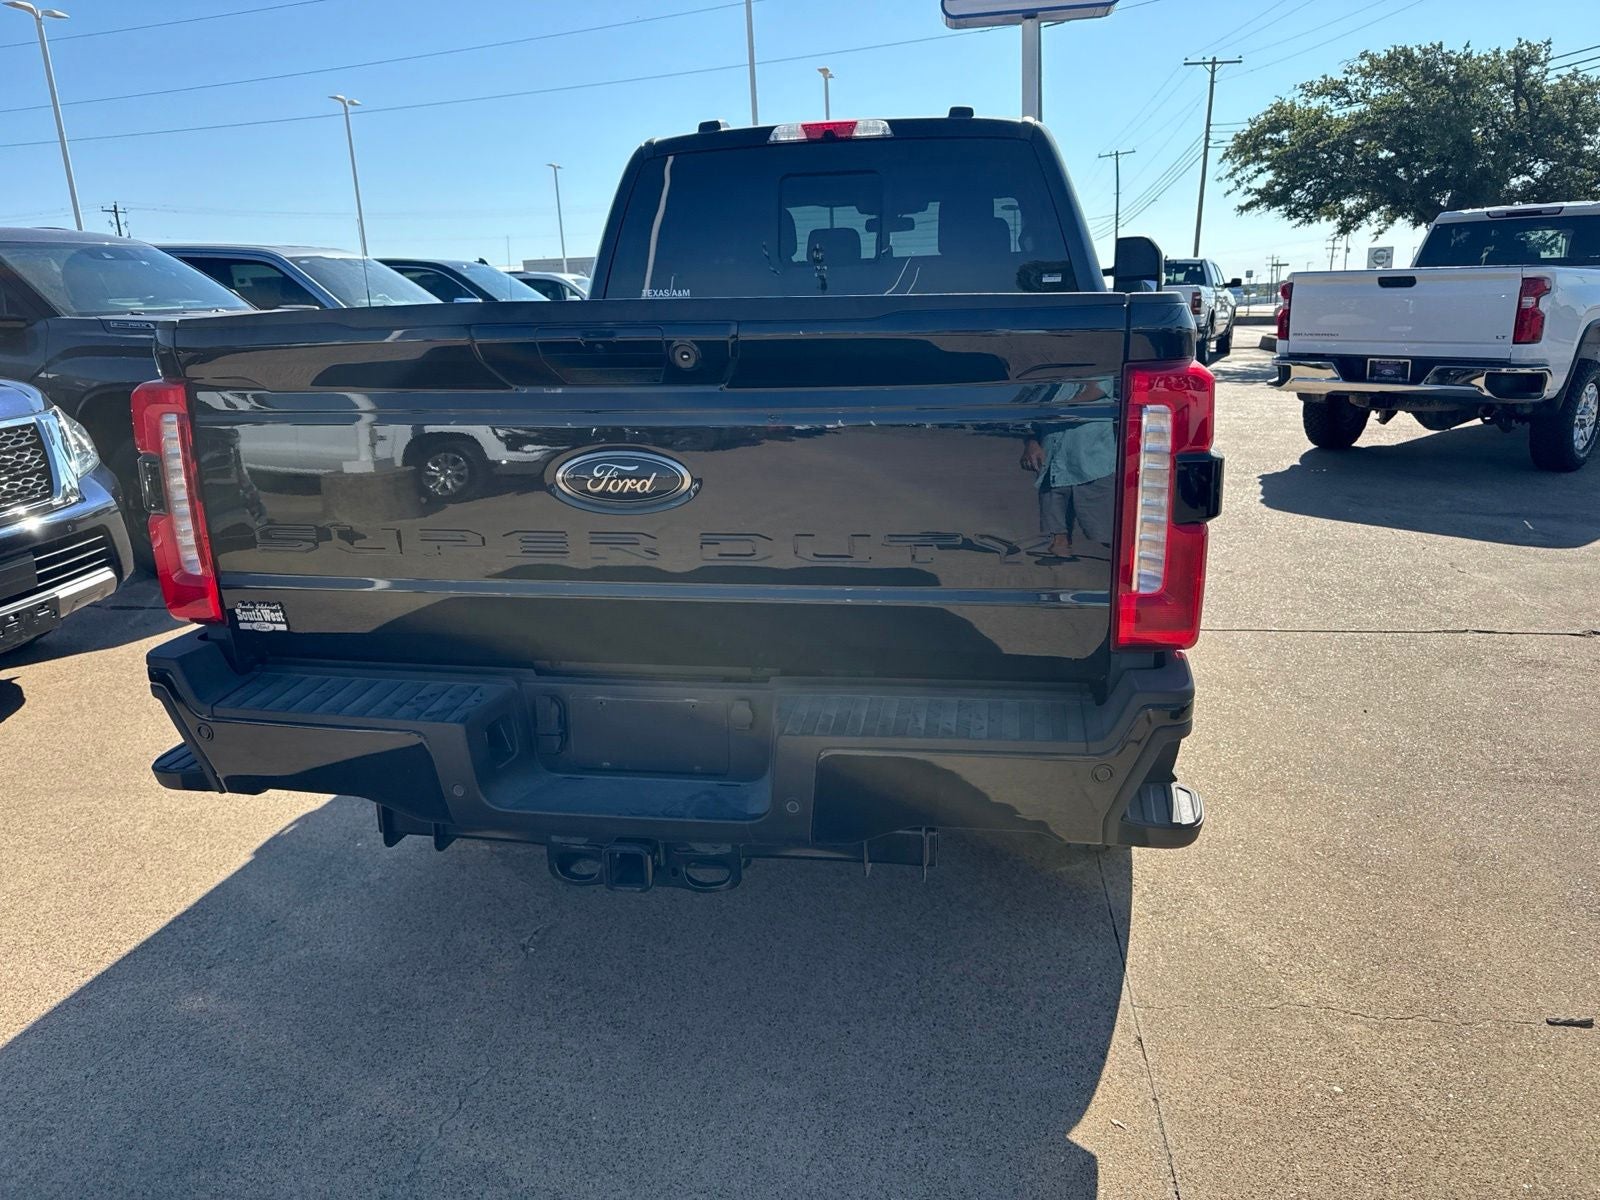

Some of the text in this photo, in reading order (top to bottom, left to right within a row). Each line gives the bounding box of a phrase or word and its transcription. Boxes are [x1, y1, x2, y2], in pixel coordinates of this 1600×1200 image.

[642, 289, 691, 297] TEXAS A&M
[586, 463, 657, 494] Ford
[255, 523, 1056, 565] SUPER DUTY
